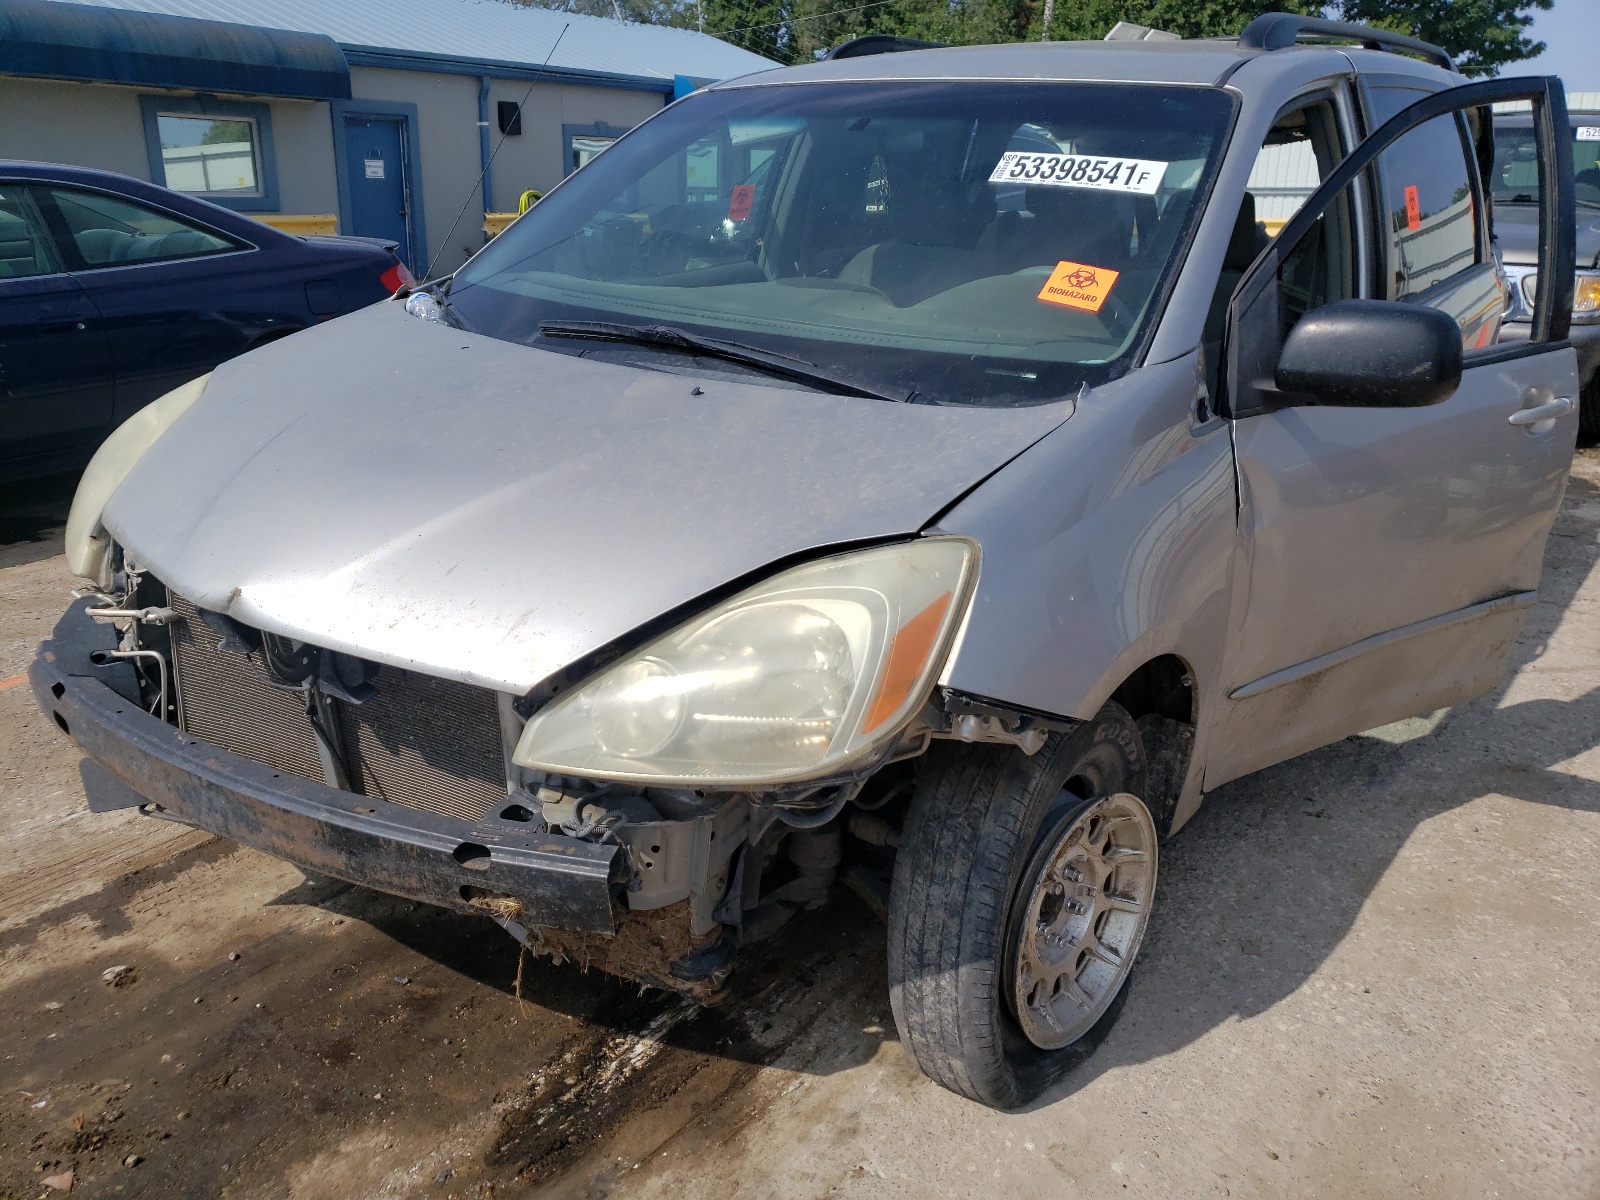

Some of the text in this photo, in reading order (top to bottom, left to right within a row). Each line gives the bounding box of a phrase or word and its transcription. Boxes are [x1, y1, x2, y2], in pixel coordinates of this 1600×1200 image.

[1009, 155, 1139, 186] 53398541
[1136, 171, 1150, 185] F
[1047, 286, 1098, 302] BIOHAZARD
